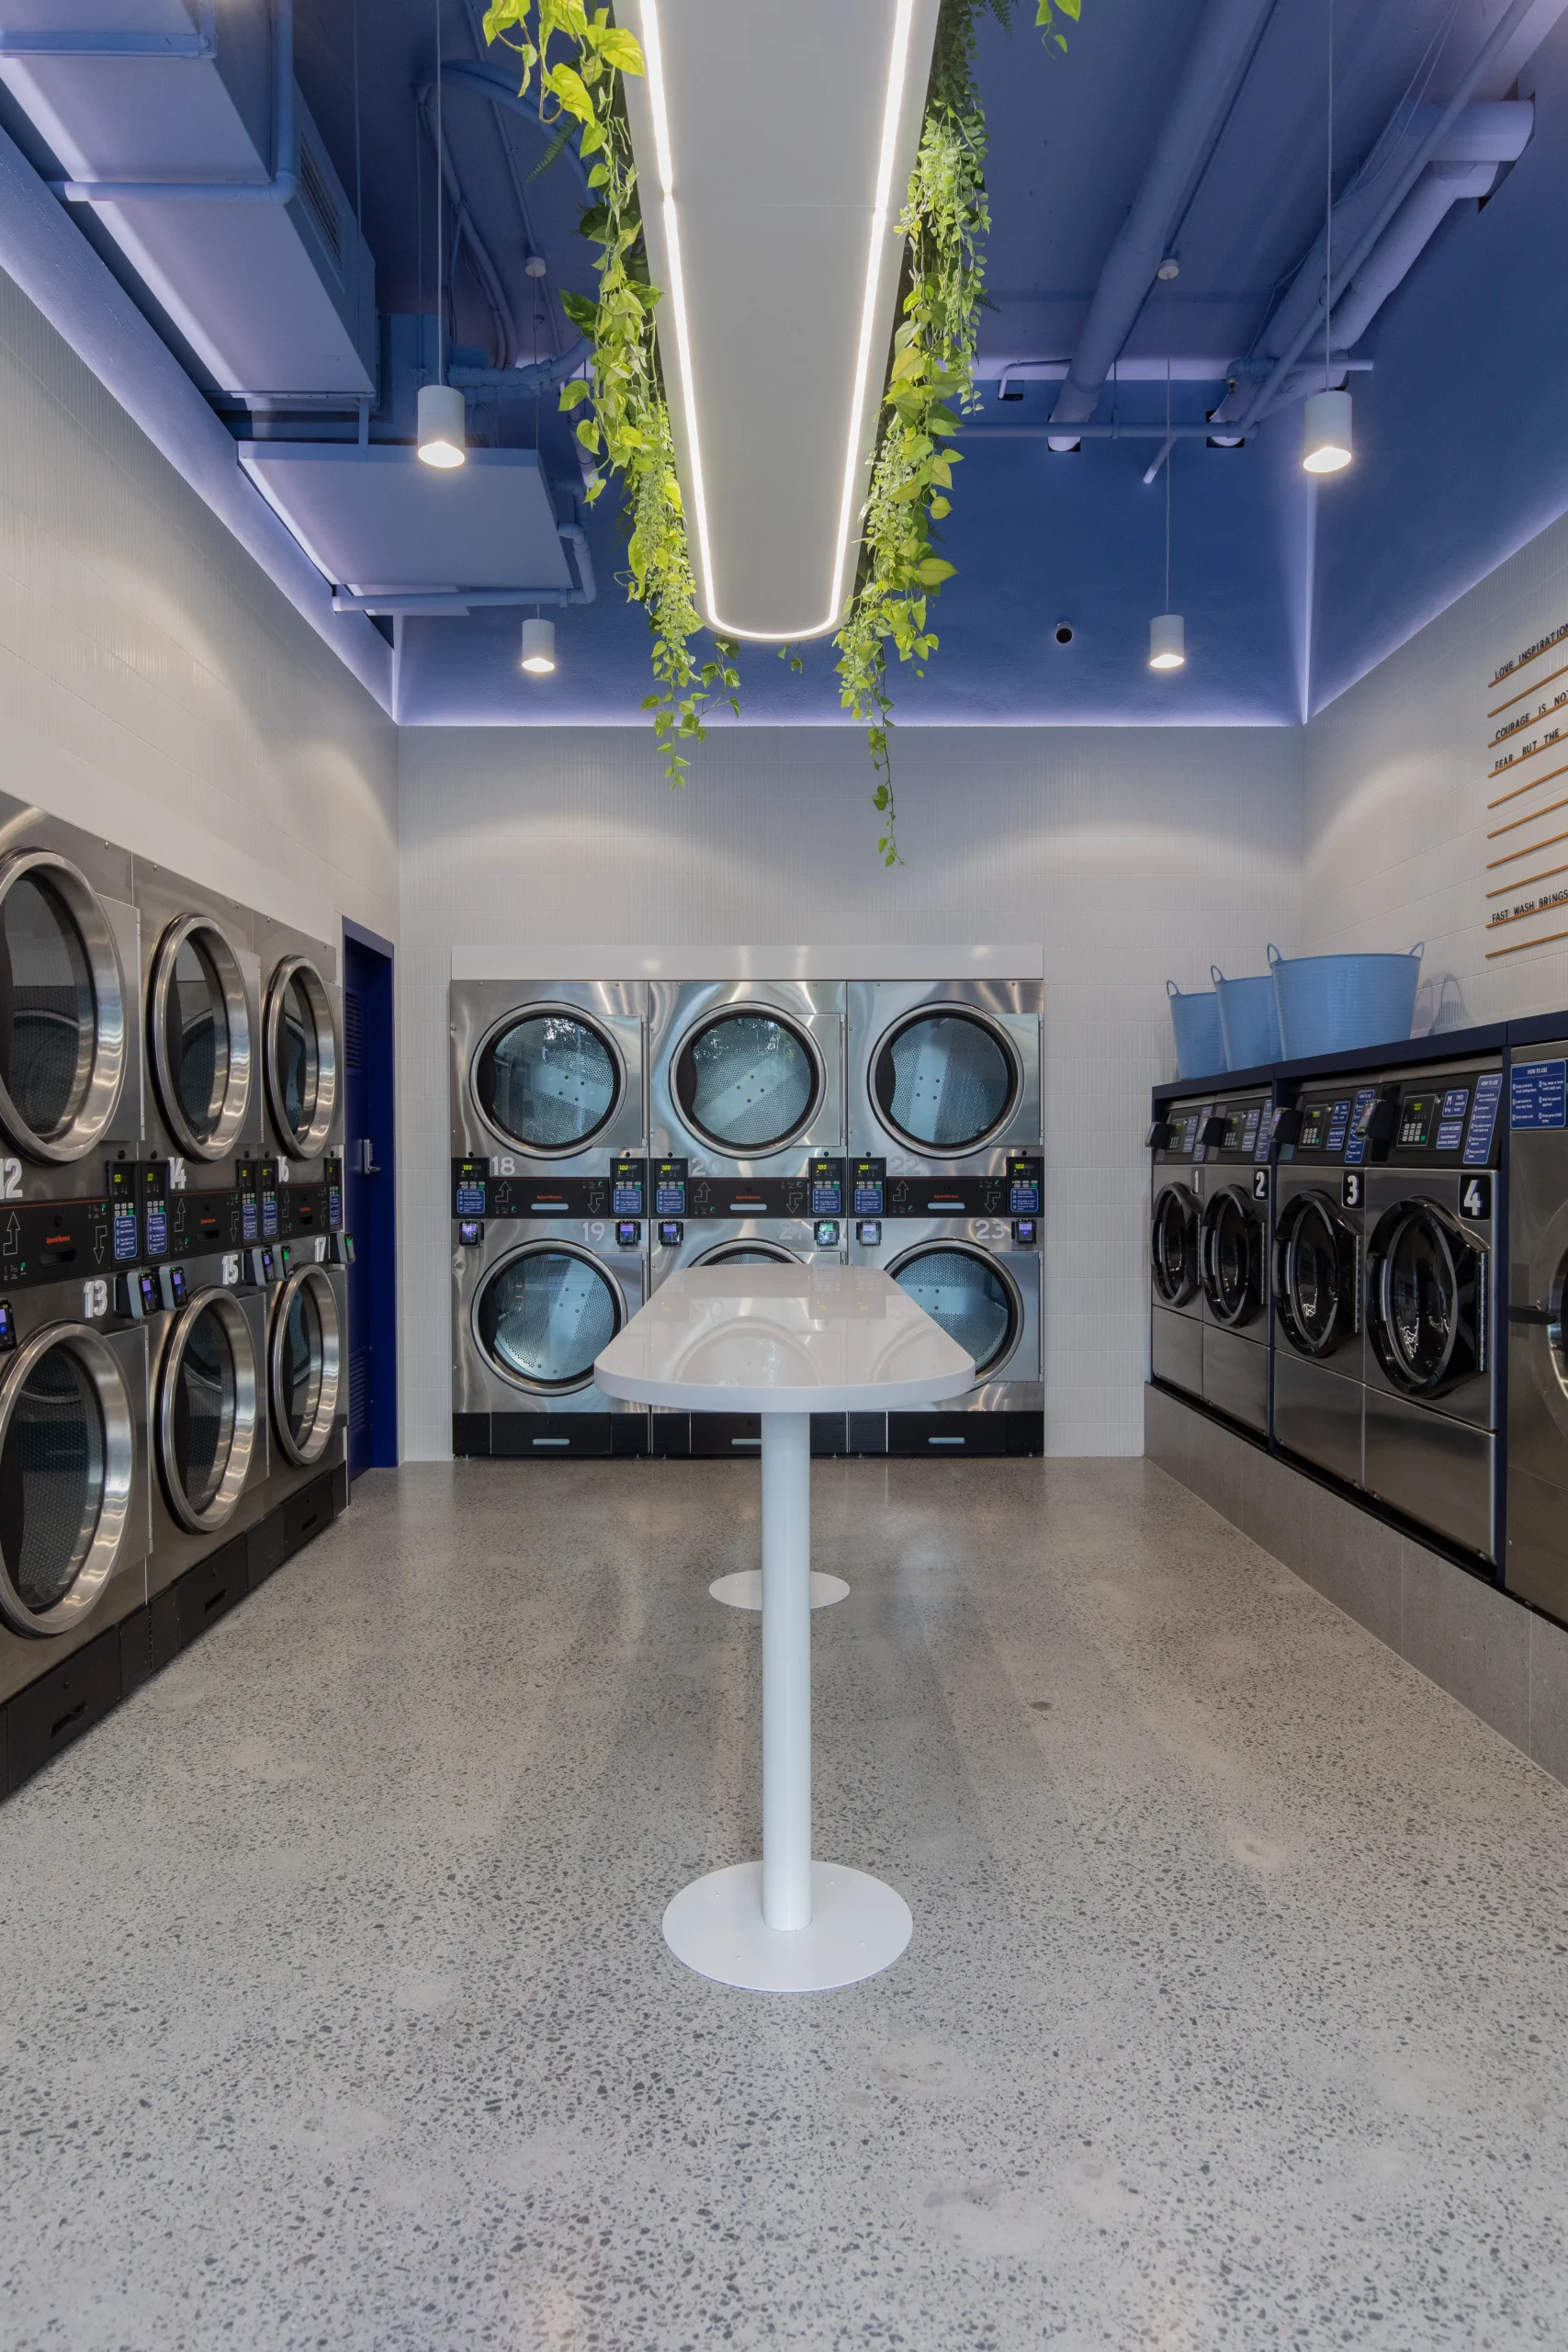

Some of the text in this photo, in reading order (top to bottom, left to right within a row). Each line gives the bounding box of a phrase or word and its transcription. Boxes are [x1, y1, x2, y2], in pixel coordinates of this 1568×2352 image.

[1495, 661, 1513, 680] LOVE
[1495, 712, 1530, 740] COURAGE
[1538, 703, 1546, 715] IS
[1495, 728, 1560, 770] FEAR BUT THE
[1492, 889, 1568, 923] FAST WASH BRINGS
[168, 1157, 186, 1189] 14
[276, 1156, 289, 1182] 16
[492, 1156, 516, 1176] 18
[691, 1157, 724, 1176] 20
[890, 1155, 921, 1176] 22
[1194, 1170, 1199, 1193] 1
[1256, 1171, 1265, 1197] 2
[1347, 1175, 1359, 1205] 3
[1463, 1179, 1482, 1216] 4
[582, 1221, 605, 1242] 19
[778, 1221, 802, 1240] 21
[975, 1220, 1005, 1239] 23
[315, 1237, 327, 1263] 17
[222, 1254, 239, 1285] 15
[84, 1279, 108, 1318] 13
